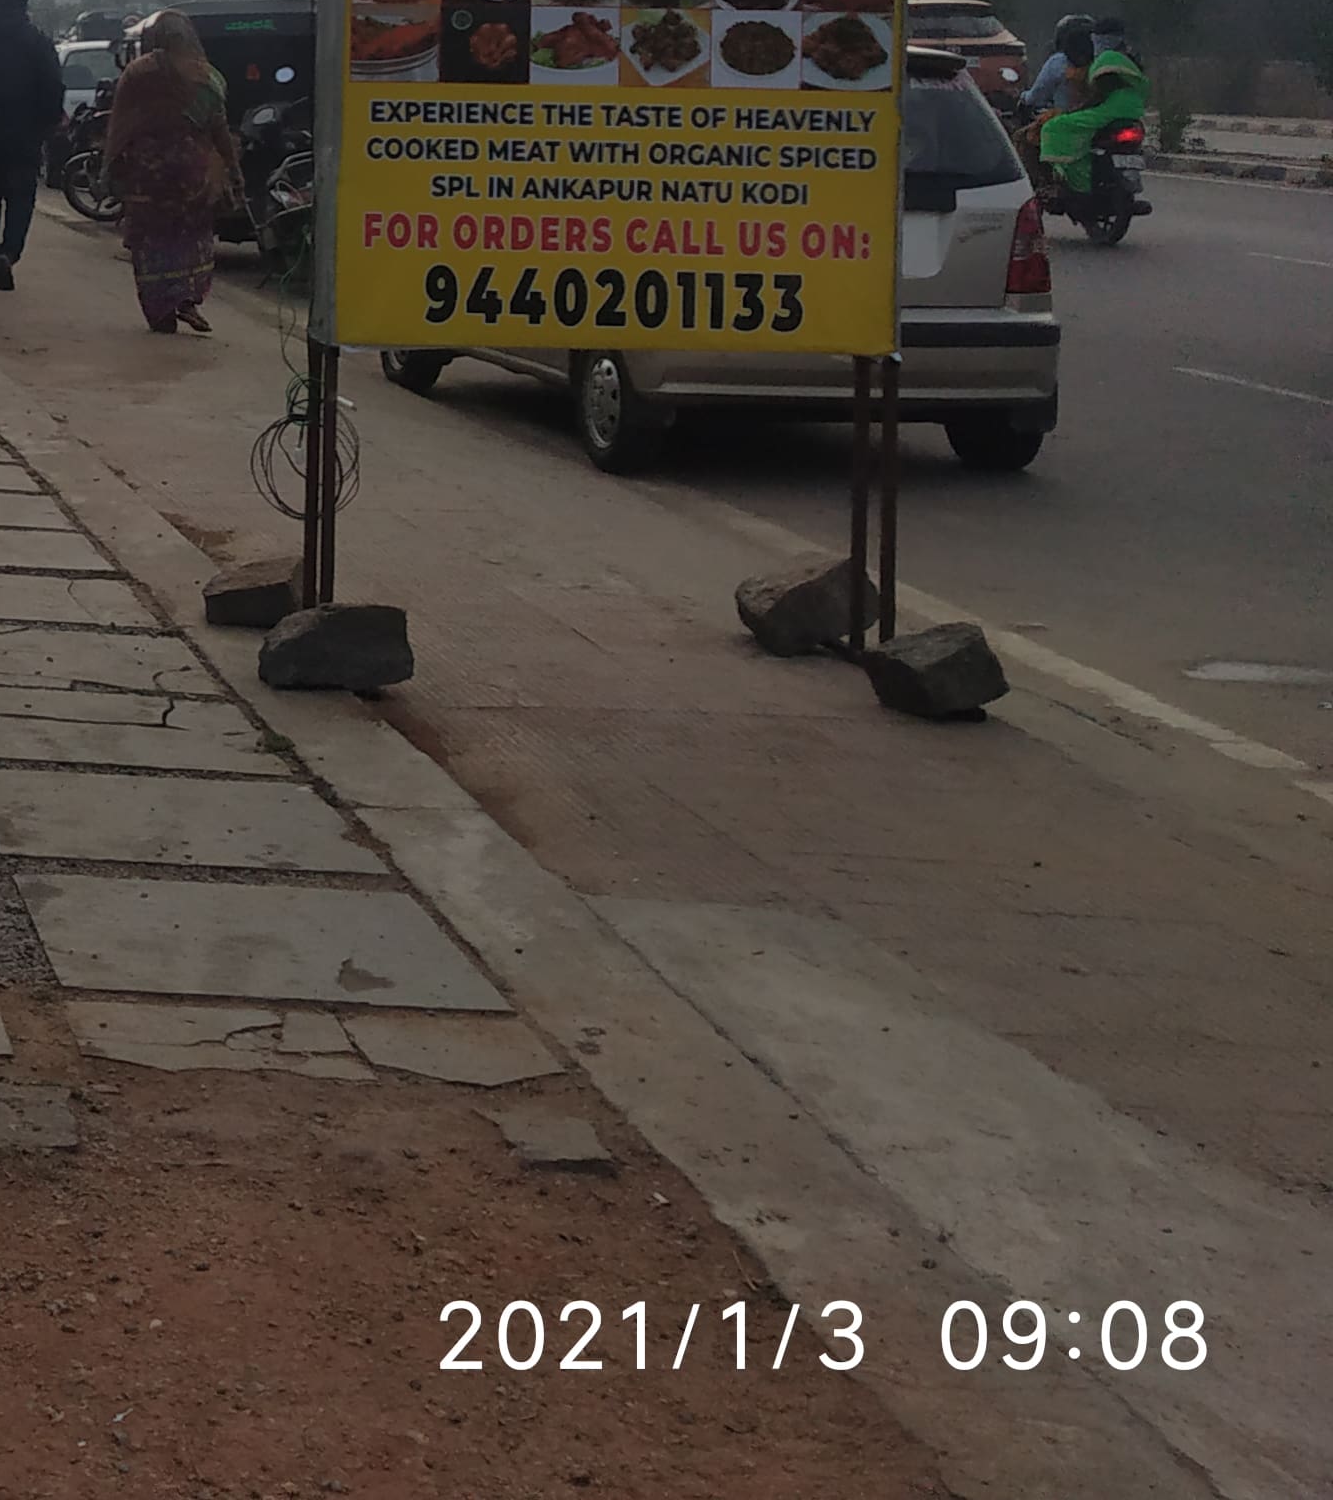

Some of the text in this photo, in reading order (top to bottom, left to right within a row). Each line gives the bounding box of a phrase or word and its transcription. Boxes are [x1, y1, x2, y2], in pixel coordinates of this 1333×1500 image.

[370, 100, 875, 132] EXPERIENCE THE TASTE OF HEAVENLY
[366, 137, 876, 169] COOKED MEAT WITH ORGANIC SPICED
[431, 175, 807, 205] SPL IN ANKAPUR NATU KODI
[364, 212, 869, 259] FOR ORDERS CALL US ON:
[425, 264, 803, 332] 9440201133
